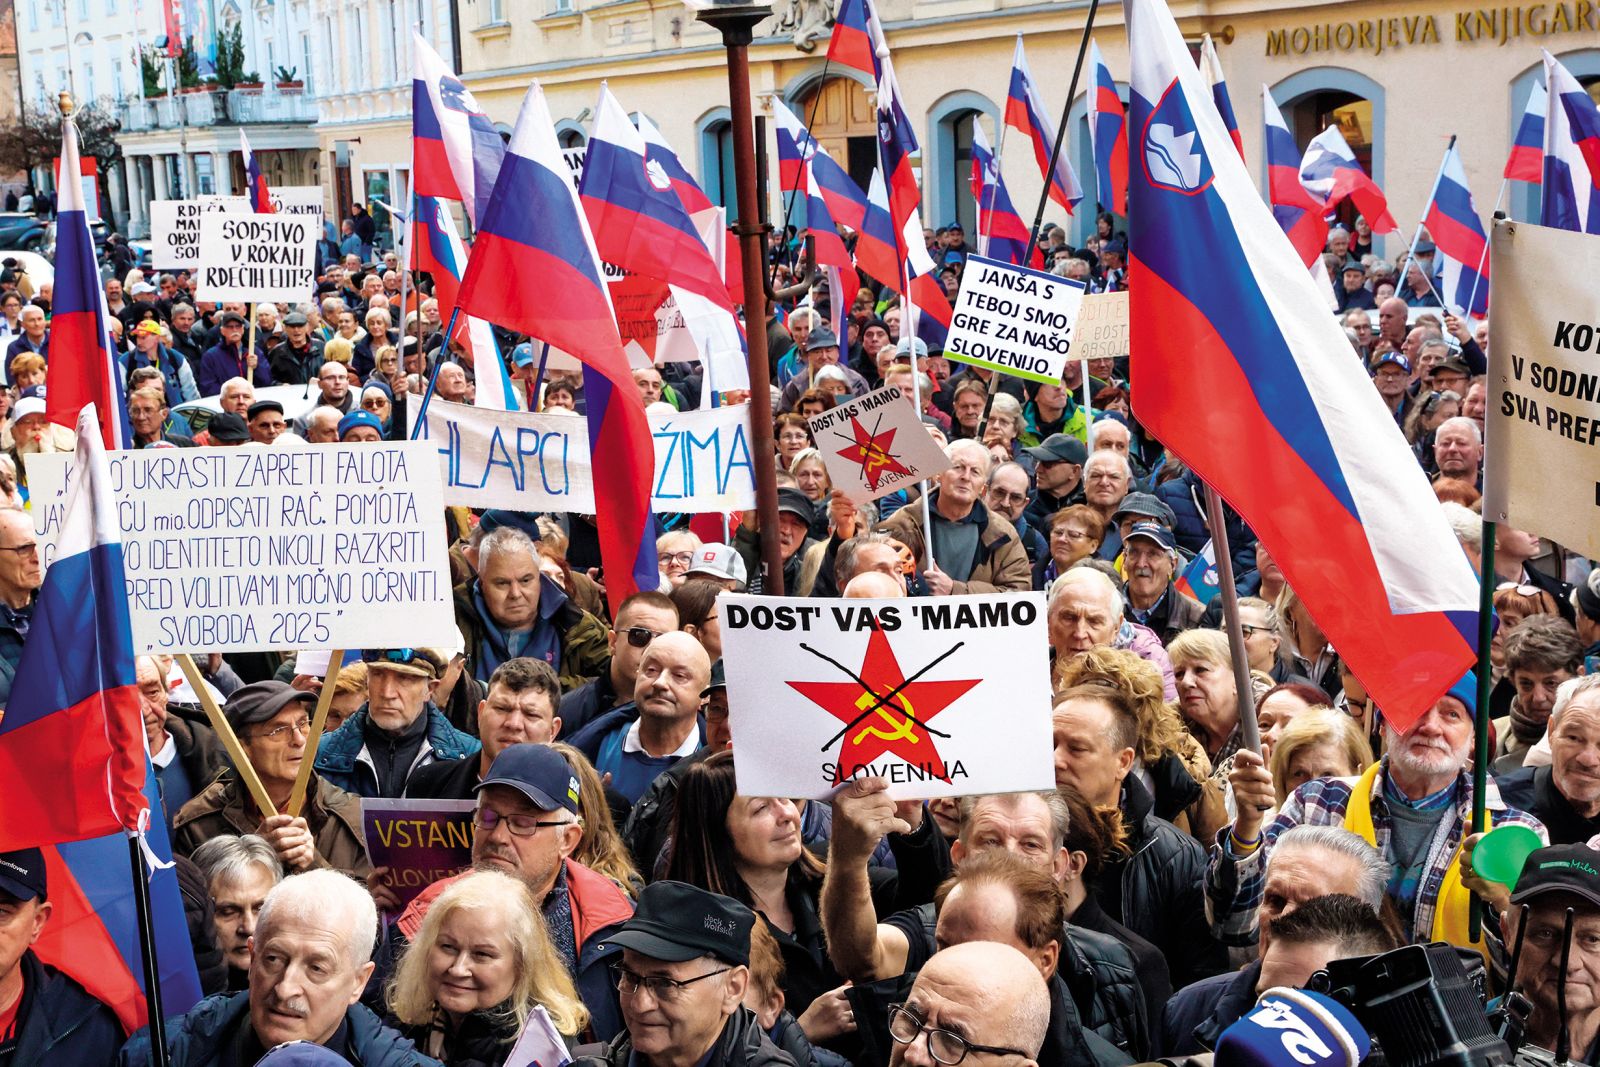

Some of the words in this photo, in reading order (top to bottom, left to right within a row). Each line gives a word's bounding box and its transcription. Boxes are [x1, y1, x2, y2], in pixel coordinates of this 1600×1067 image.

[1265, 15, 1440, 57] MOHORJEVA
[1455, 0, 1600, 47] KNJIGAR
[223, 220, 305, 244] SODSTVO
[206, 262, 265, 288] RDEČIH
[231, 244, 242, 262] V
[248, 244, 304, 267] ROKAH
[979, 268, 1038, 296] JANŠA
[1043, 284, 1055, 300] S
[966, 290, 1020, 318] TEBOJ
[1024, 306, 1071, 334] SMO,
[953, 313, 991, 335] GRE
[995, 322, 1018, 343] ZA
[1023, 332, 1070, 355] NAŠO
[1094, 324, 1128, 341] BOST
[951, 337, 1053, 377] SLOVENIJO.
[1512, 355, 1524, 381] V
[1530, 362, 1600, 404] SODN
[811, 414, 835, 434] DOST'
[836, 404, 859, 423] VAS
[858, 387, 901, 412] 'MAMO
[1501, 390, 1540, 427] SVA
[133, 456, 226, 490] UKRASTI
[235, 452, 324, 488] ZAPRETI
[336, 450, 408, 484] FALOTA
[651, 422, 758, 499] ŽIMA
[864, 464, 919, 492] SLOVENIJA
[154, 513, 186, 532] mio.
[187, 496, 270, 530] ODPISATI
[281, 490, 326, 528] RAČ.
[335, 492, 418, 526] POMOTA
[148, 536, 261, 570] IDENTITETO
[269, 533, 324, 566] NIKOLI
[335, 531, 425, 565] RAZKRITI
[180, 575, 279, 609] VOLITVAMI
[287, 568, 351, 605] MOČNO
[362, 567, 444, 604] OČRNITI.
[726, 603, 821, 631] DOST'
[831, 606, 902, 632] VAS
[912, 600, 1037, 632] 'MAMO
[821, 760, 969, 784] SLOVENIJA
